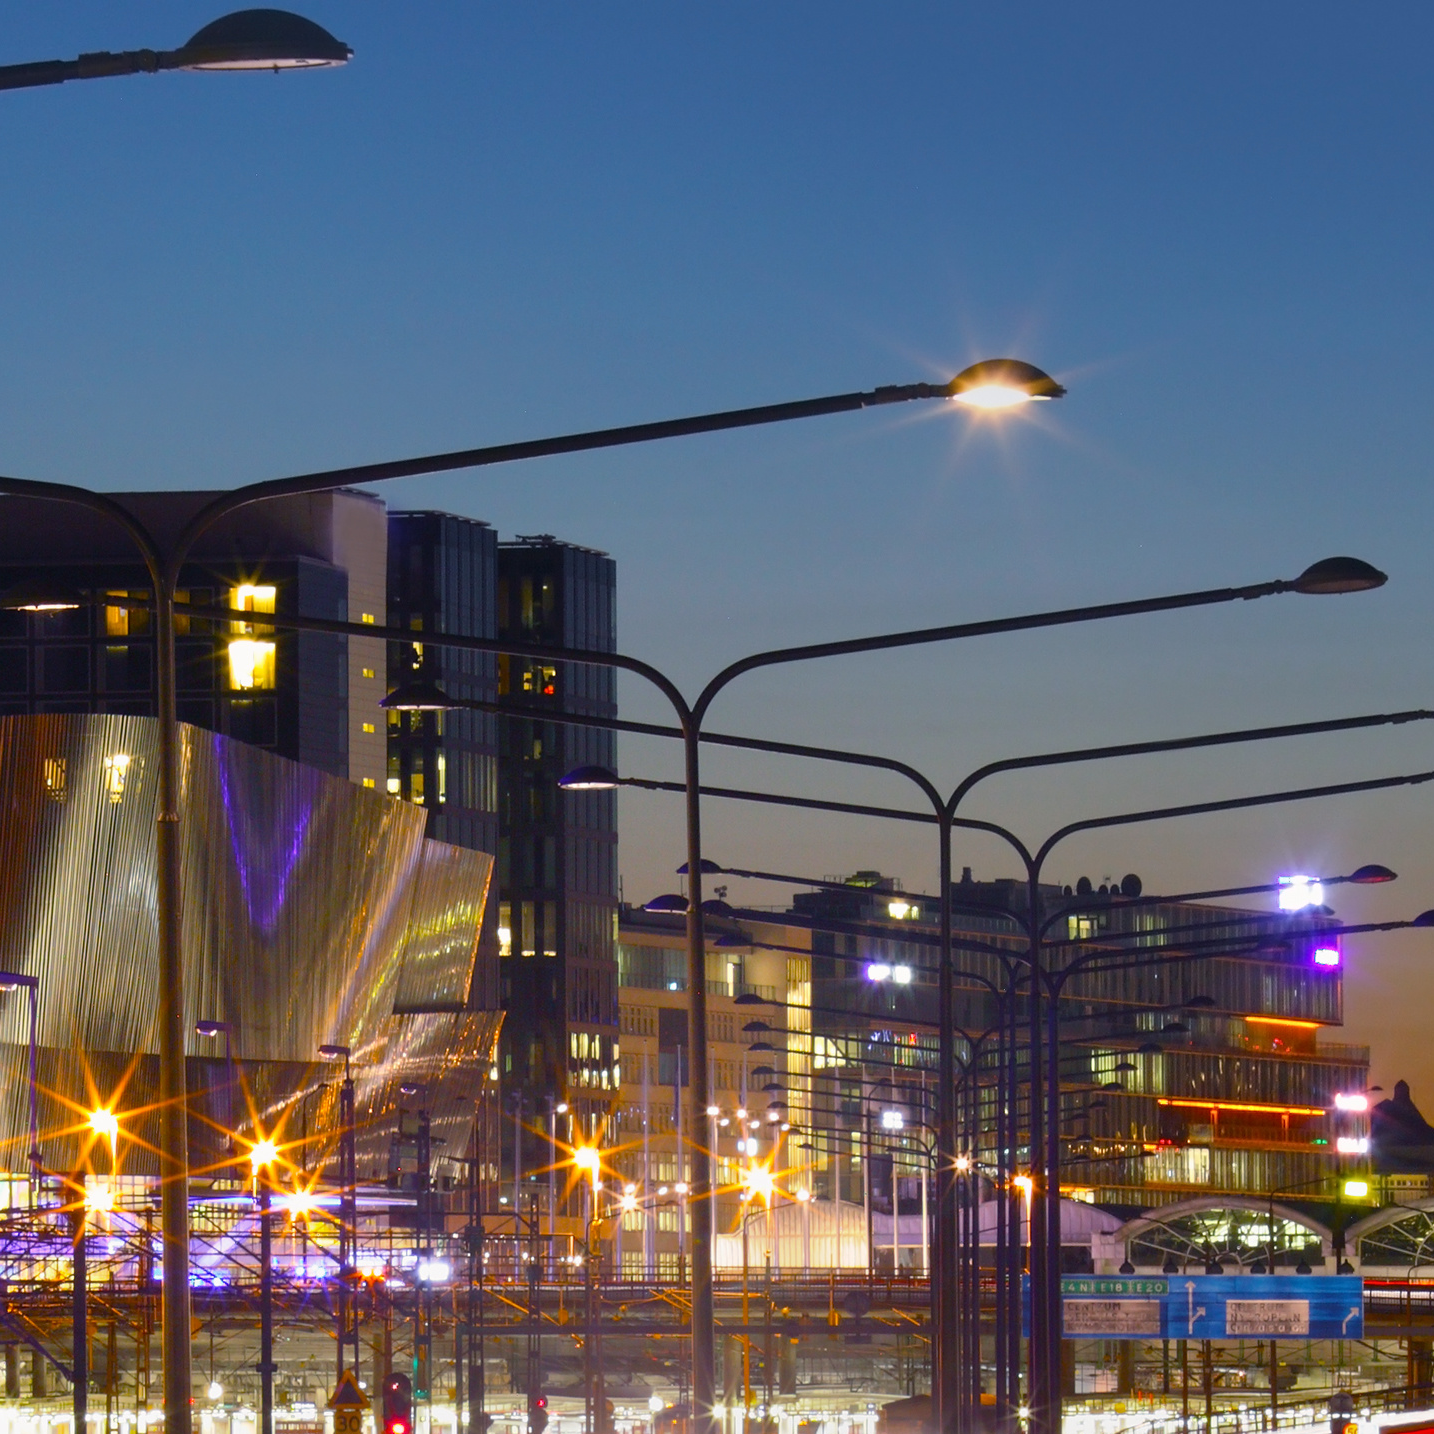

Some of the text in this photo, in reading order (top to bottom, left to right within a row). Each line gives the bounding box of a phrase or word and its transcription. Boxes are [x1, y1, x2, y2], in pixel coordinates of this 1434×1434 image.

[1100, 1282, 1124, 1292] E18
[1136, 1282, 1164, 1292] E20
[335, 1415, 361, 1433] 30
